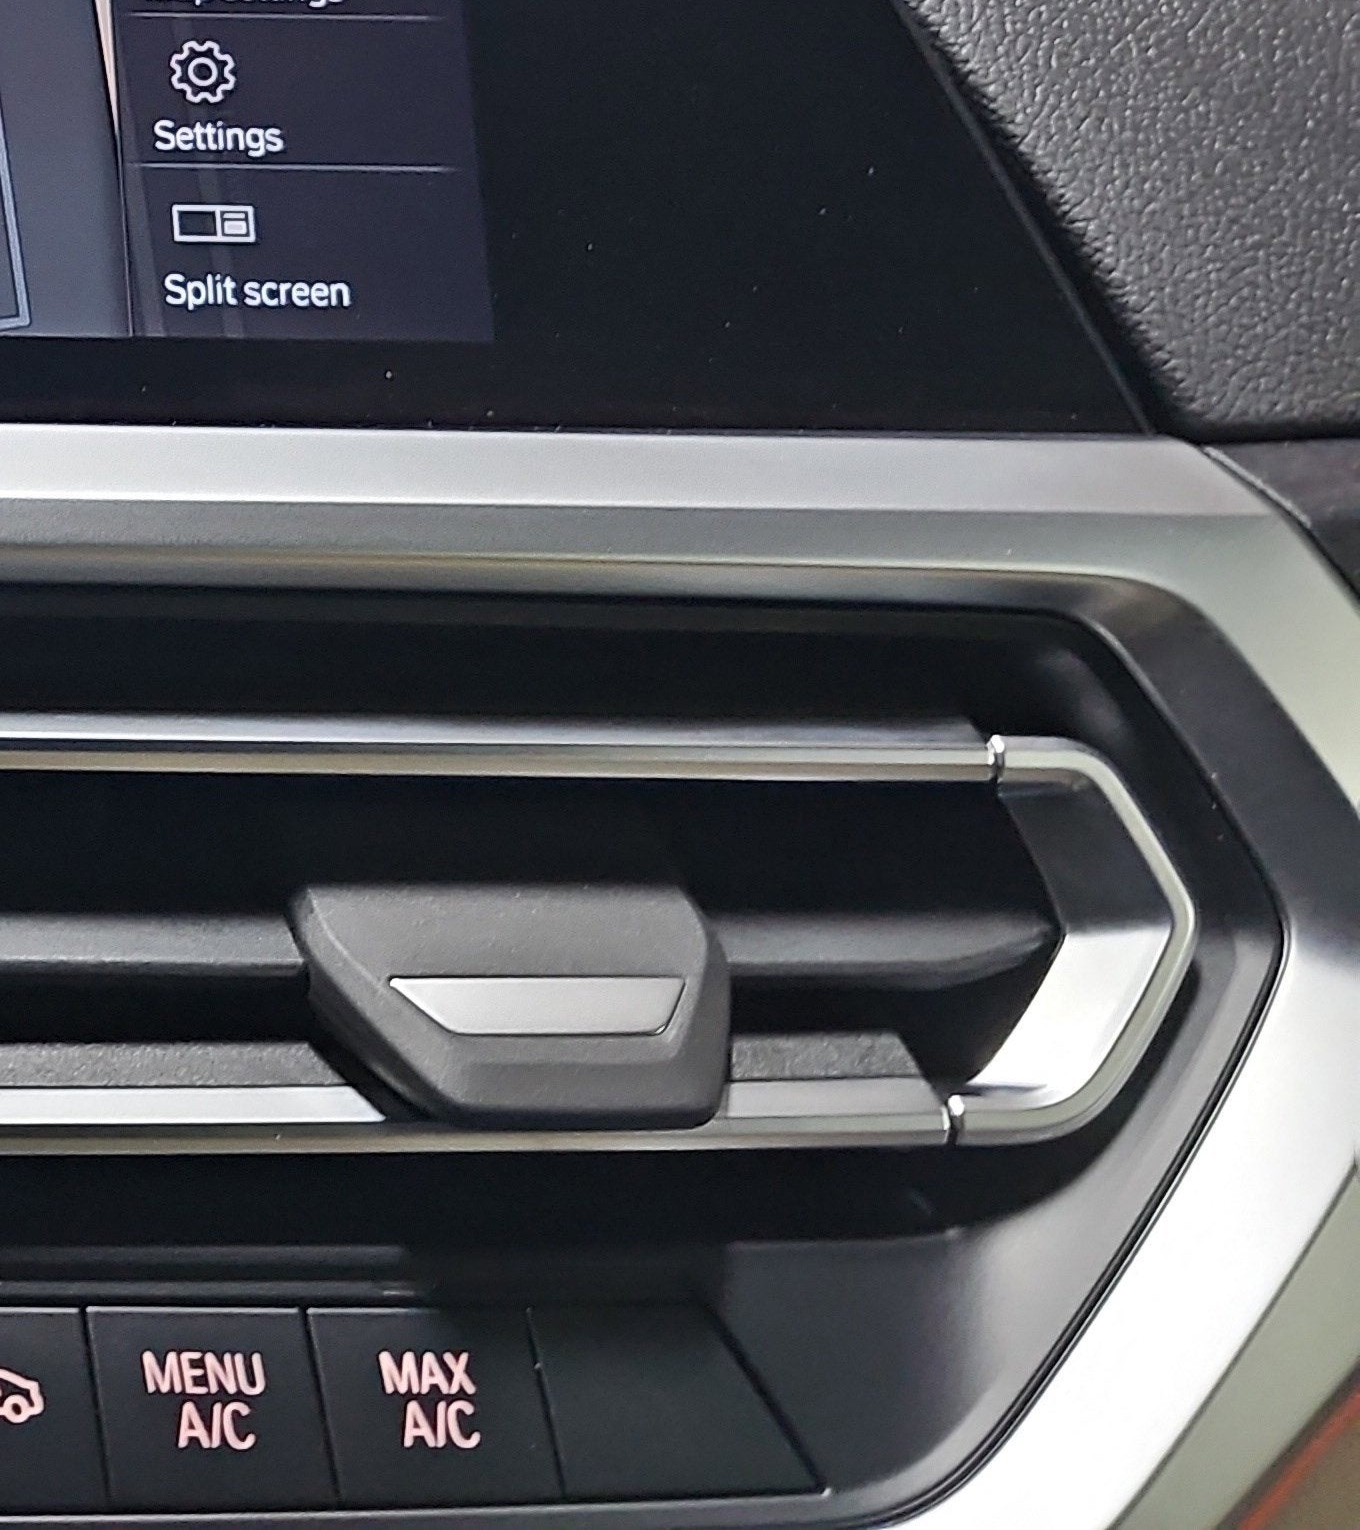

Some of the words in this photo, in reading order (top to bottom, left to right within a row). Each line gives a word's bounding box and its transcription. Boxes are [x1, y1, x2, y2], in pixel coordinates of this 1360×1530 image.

[153, 120, 284, 157] Settings
[164, 274, 235, 310] Split
[244, 279, 351, 307] screen
[140, 1350, 266, 1396] MENU
[377, 1350, 477, 1396] MAX
[177, 1401, 256, 1451] A/C
[402, 1401, 481, 1450] A/C
